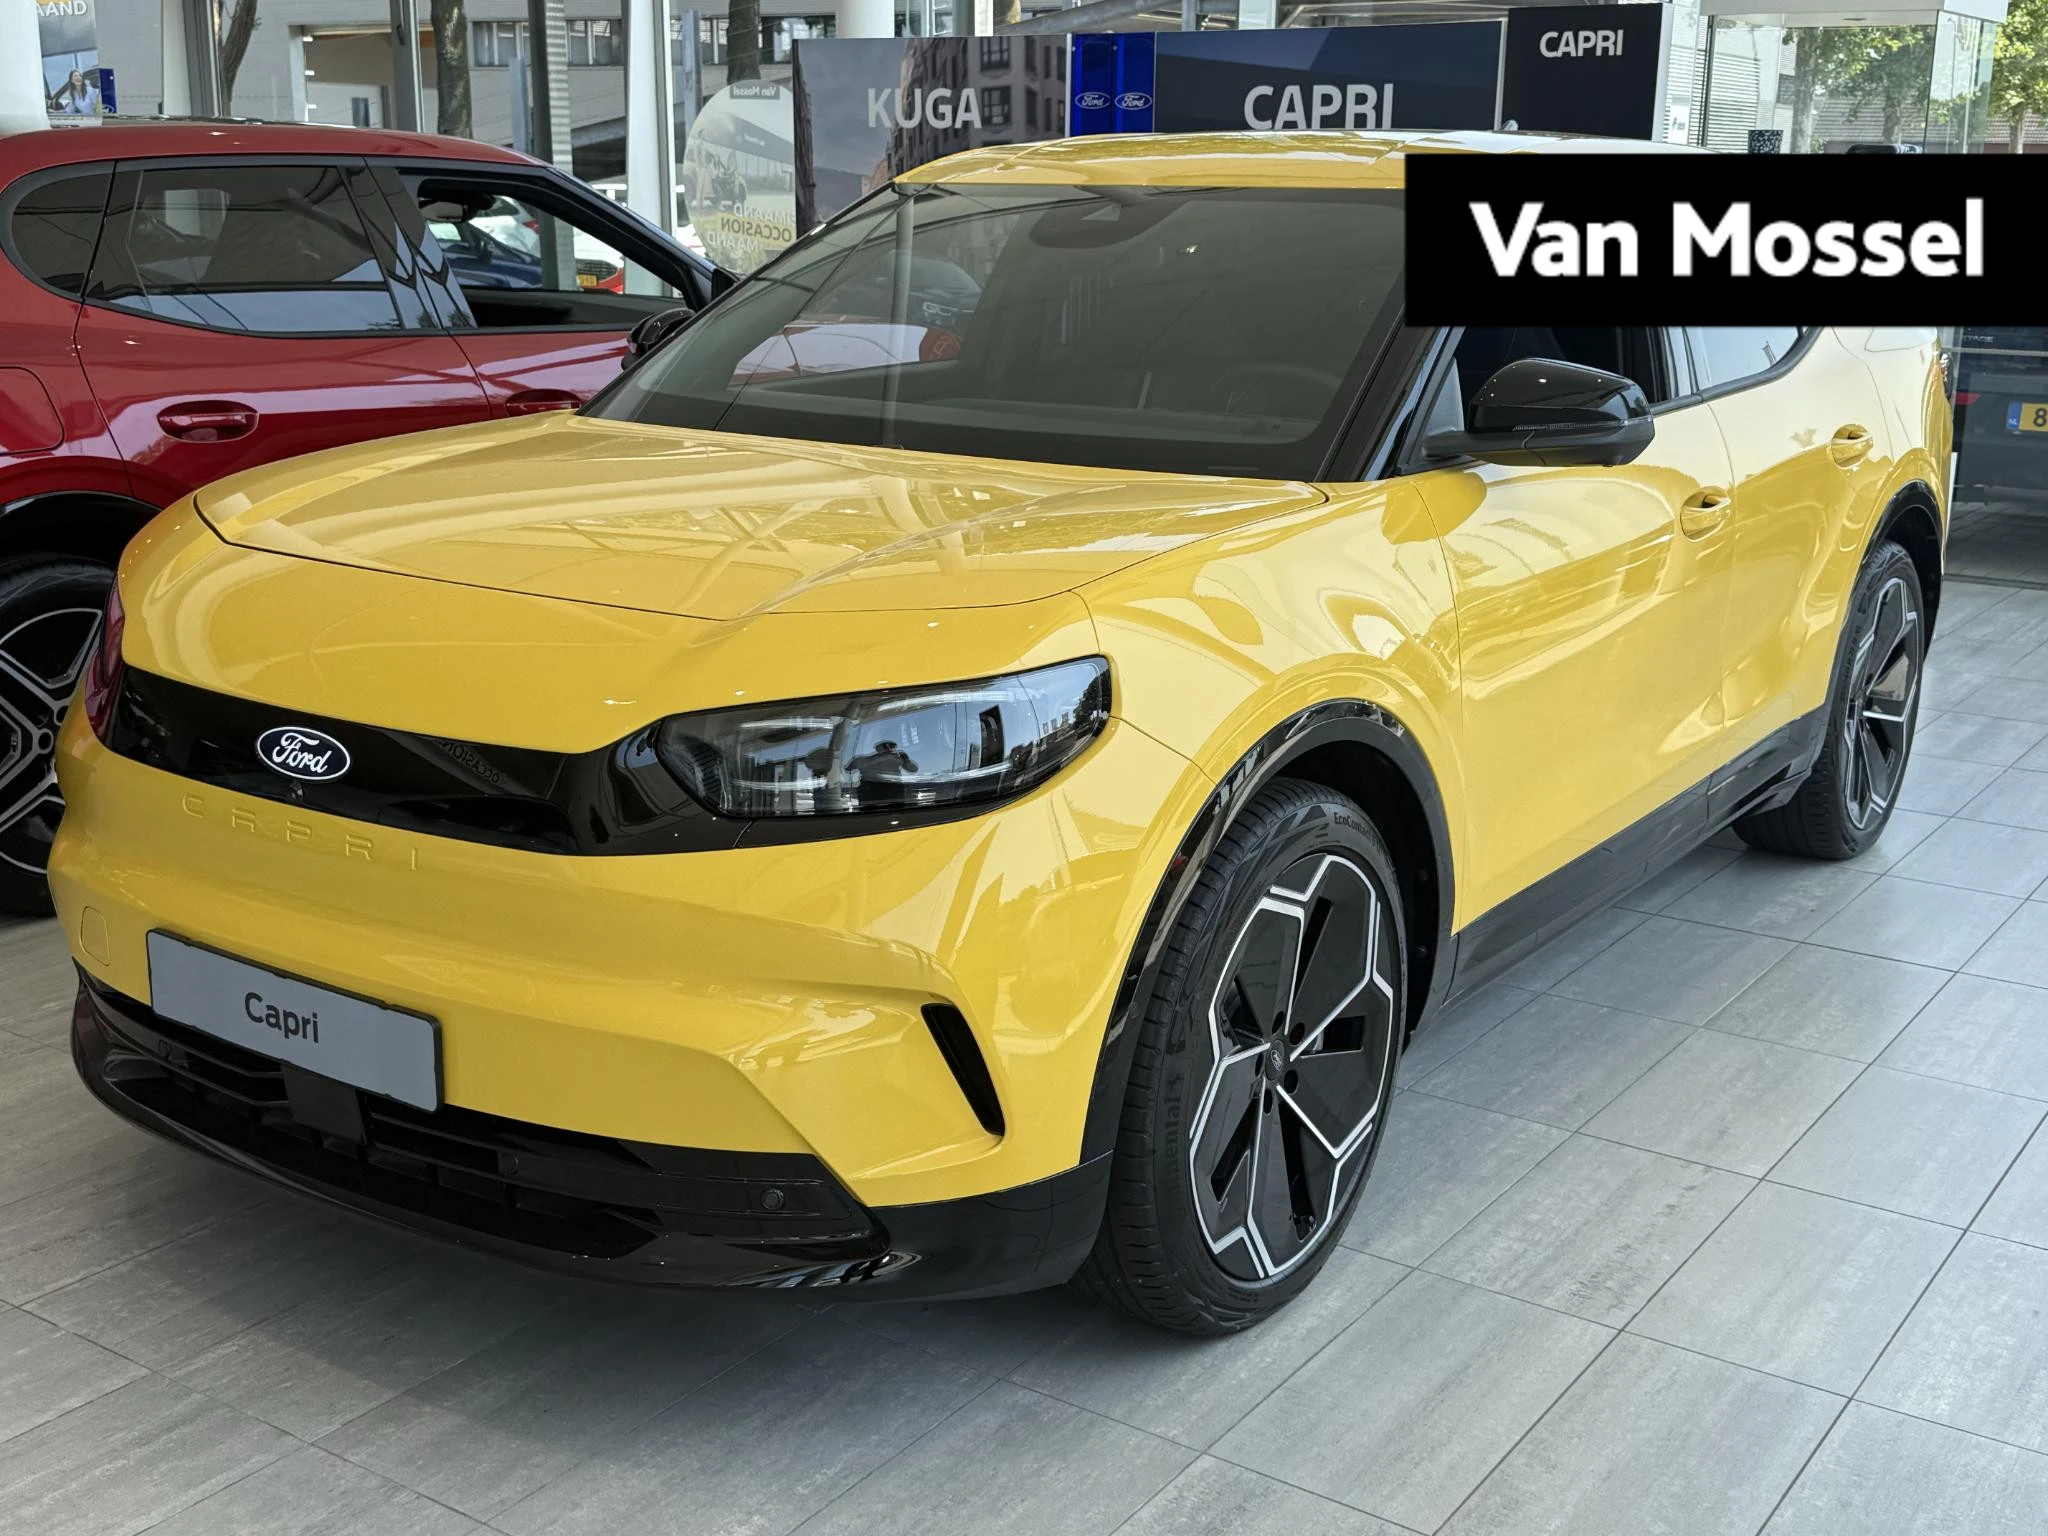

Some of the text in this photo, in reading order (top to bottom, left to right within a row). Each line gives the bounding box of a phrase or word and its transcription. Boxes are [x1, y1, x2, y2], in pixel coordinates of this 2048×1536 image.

[1539, 29, 1624, 58] CAPRI
[867, 88, 982, 129] KUGA
[1244, 83, 1394, 130] CAPRI
[272, 732, 332, 774] Ford
[182, 794, 418, 871] CAPRI
[244, 991, 319, 1044] Capri
